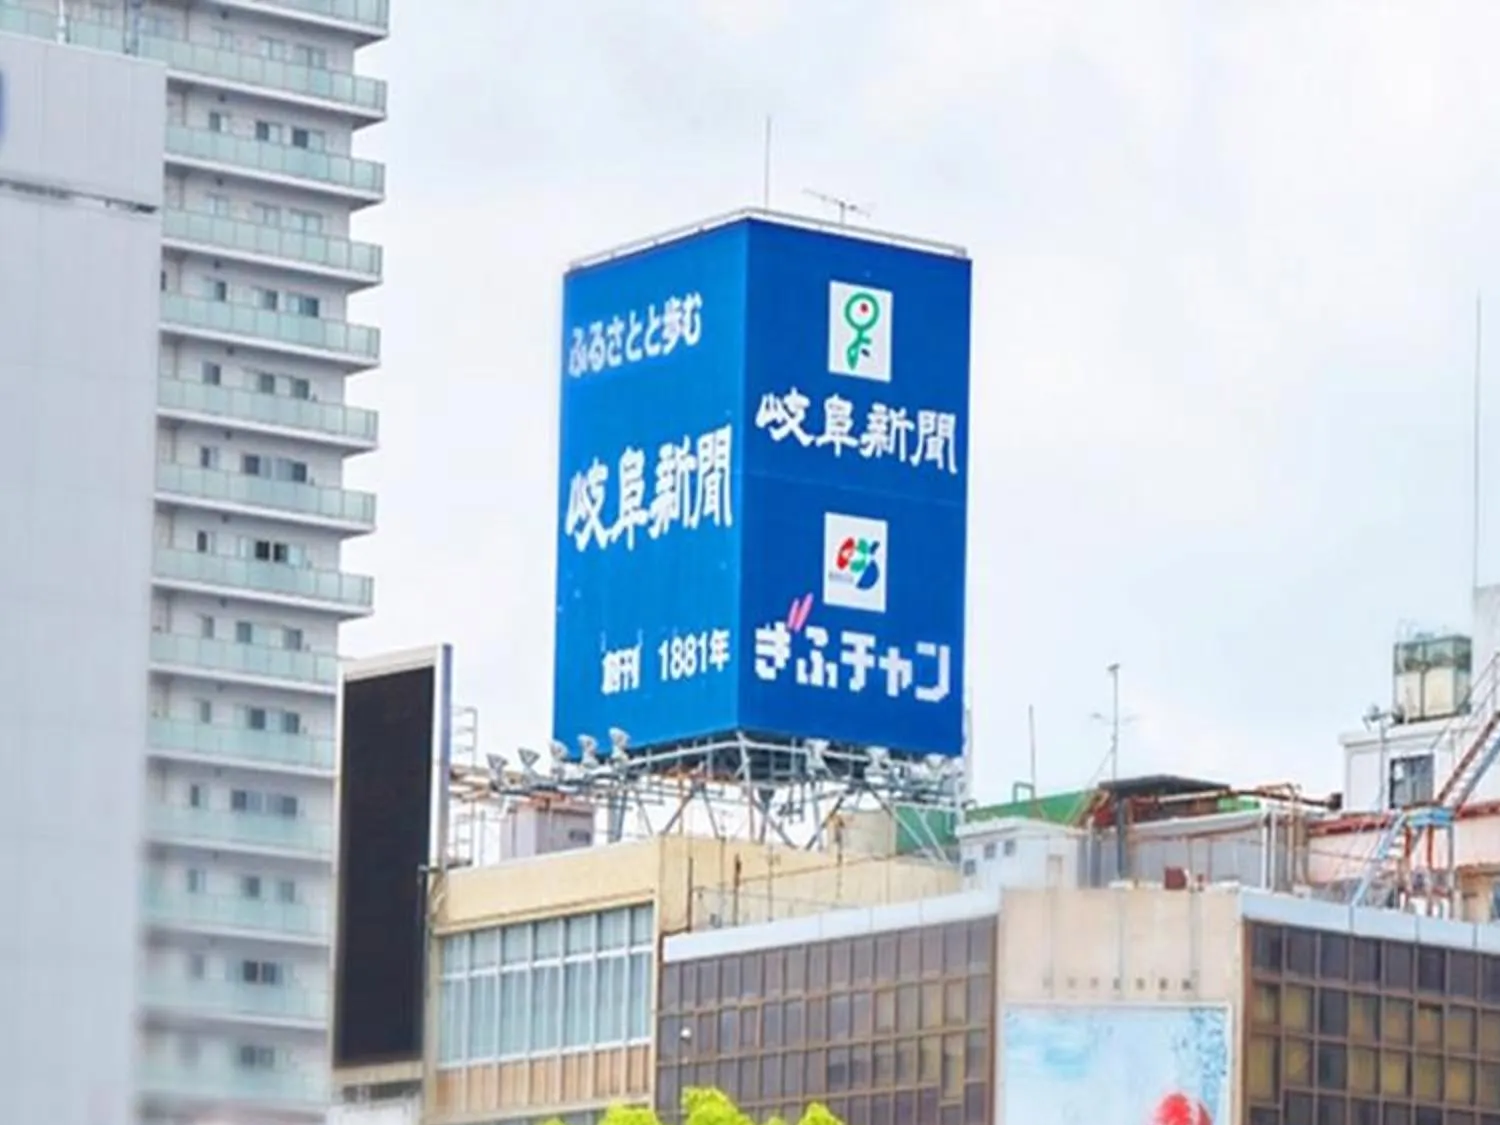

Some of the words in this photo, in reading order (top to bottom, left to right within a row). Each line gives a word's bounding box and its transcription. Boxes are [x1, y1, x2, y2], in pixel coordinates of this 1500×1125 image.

[568, 292, 702, 378] ふるさとと歩む
[755, 387, 958, 475] 岐阜新聞
[564, 423, 733, 552] 岐阜新聞
[658, 629, 730, 682] 1881年
[755, 593, 951, 702] ぎふチャン
